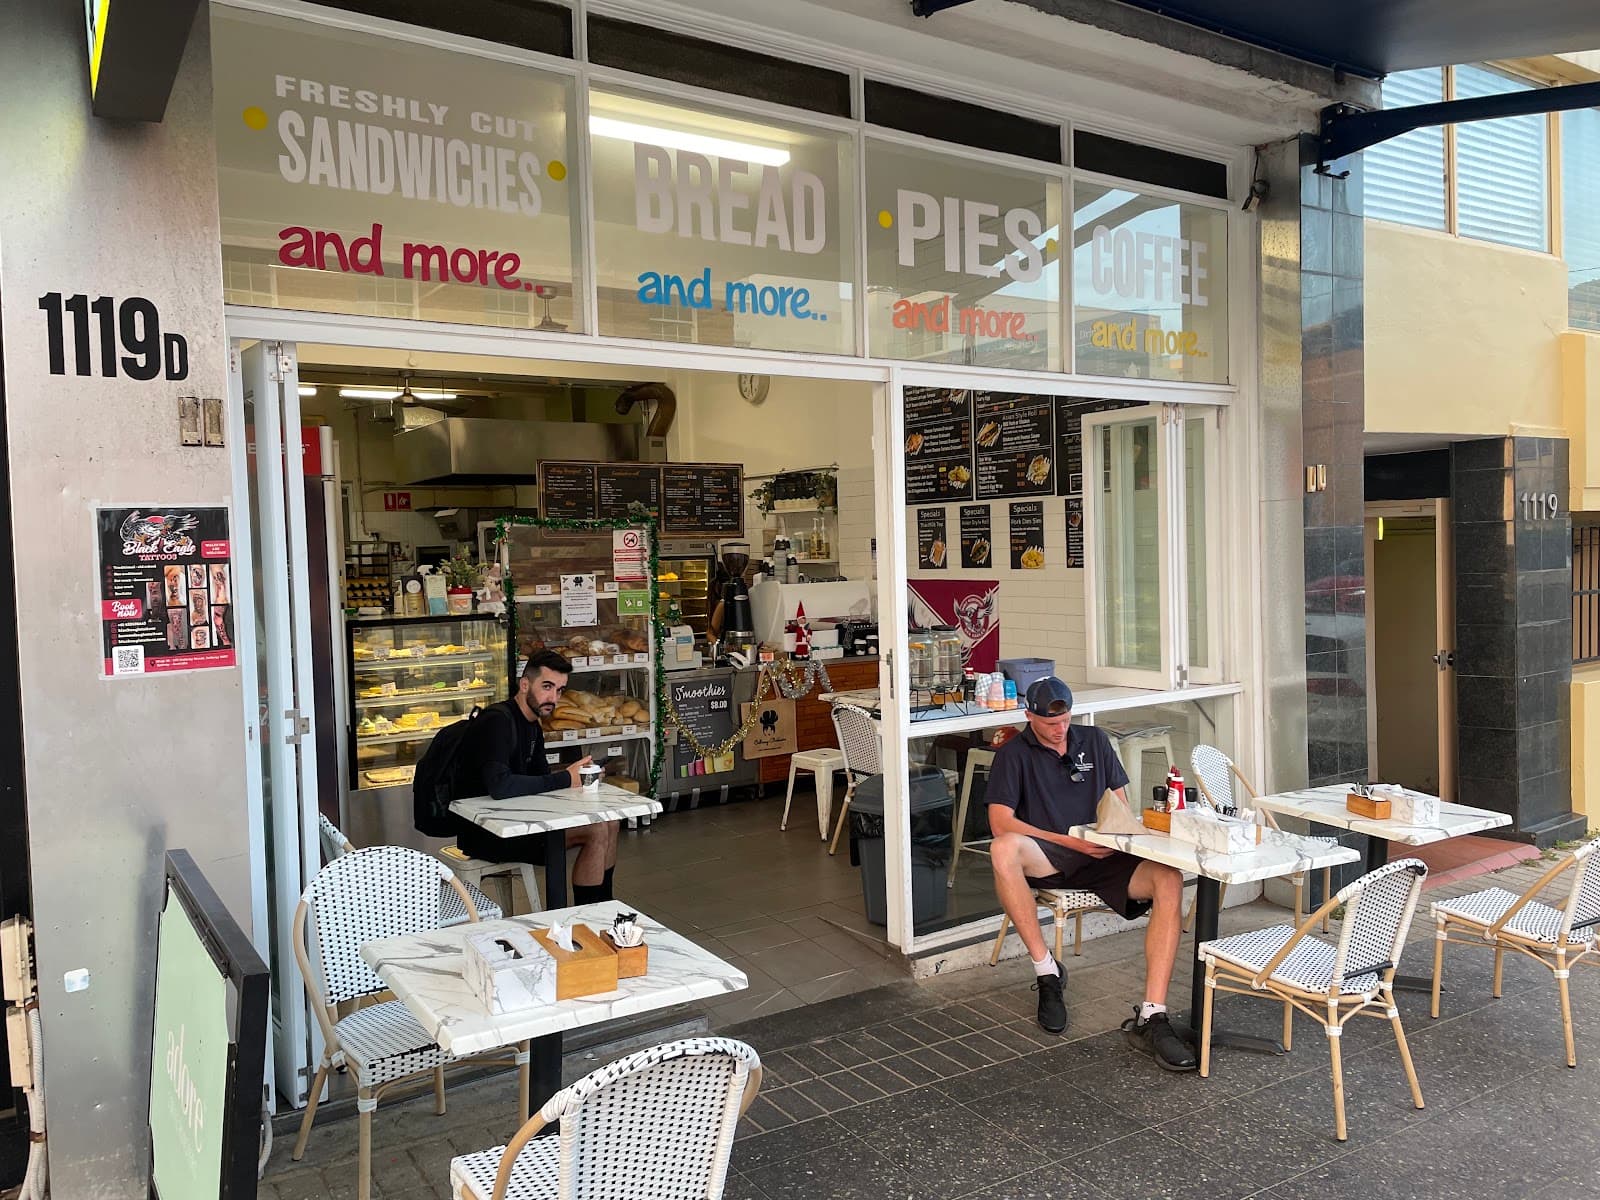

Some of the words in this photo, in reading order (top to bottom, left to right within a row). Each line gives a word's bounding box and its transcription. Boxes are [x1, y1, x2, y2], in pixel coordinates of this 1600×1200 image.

[275, 74, 448, 126] FRESHLY
[470, 111, 537, 141] CUT
[278, 109, 541, 217] SANDWICHES
[633, 142, 826, 255] BREAD
[278, 223, 383, 277] and
[896, 188, 1043, 284] PIES
[1091, 223, 1209, 309] COFFEE
[637, 266, 712, 311] and
[725, 280, 828, 322] more..
[892, 295, 951, 333] and
[1091, 317, 1137, 351] and
[920, 510, 941, 519] Specials
[963, 507, 985, 517] Specials
[1013, 503, 1038, 514] Specials
[1520, 492, 1558, 520] 1119
[122, 537, 159, 556] Black
[163, 537, 197, 556] Eagle
[138, 553, 178, 562] TATTOOS
[111, 600, 136, 613] Book
[116, 609, 138, 618] now
[675, 683, 726, 702] Smoothies
[710, 700, 728, 710] $8.00
[166, 1023, 205, 1153] adore
